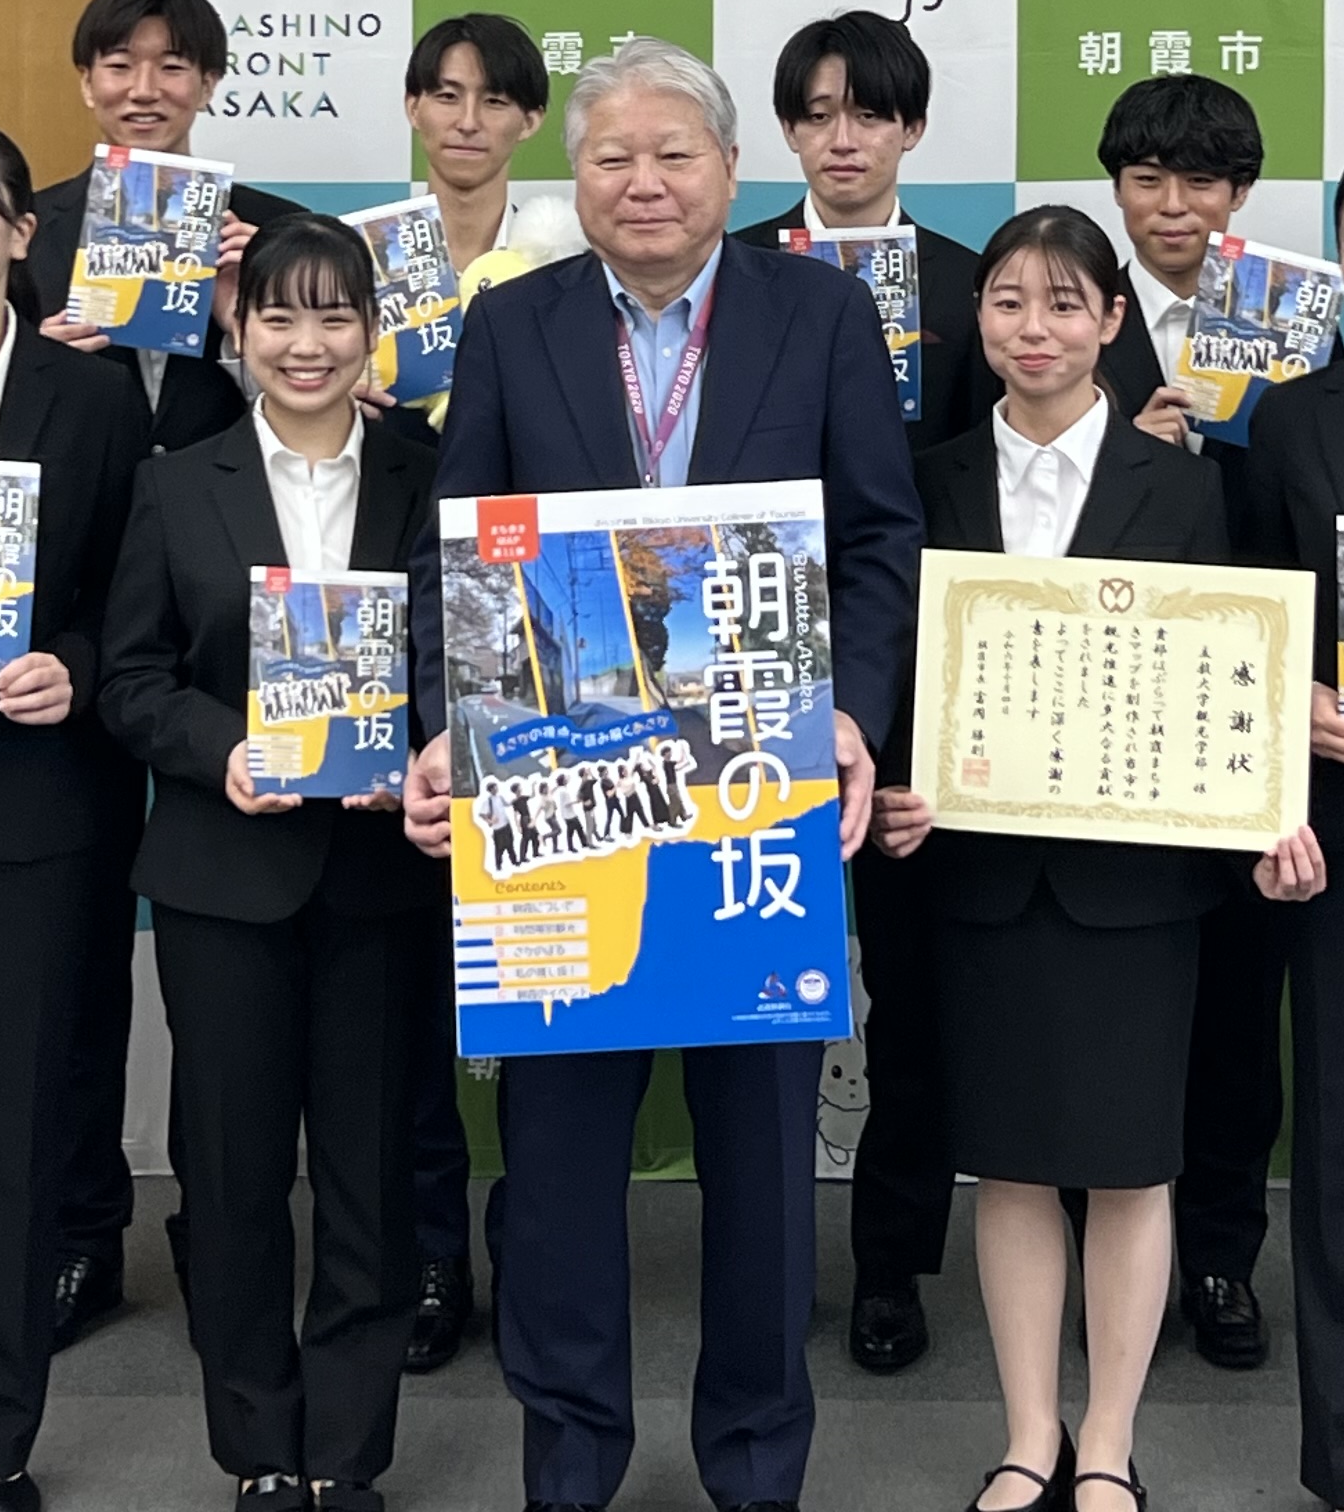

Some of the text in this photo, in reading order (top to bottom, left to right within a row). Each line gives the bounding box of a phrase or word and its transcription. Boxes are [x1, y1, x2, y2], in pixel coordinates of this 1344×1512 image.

[230, 13, 382, 38] ASHINO
[1077, 29, 1263, 76] 朝霞市
[161, 181, 217, 316] 朝霞の坂
[397, 218, 456, 356] 朝霞の坂
[617, 344, 644, 414] TOKYO 2020
[667, 345, 701, 416] TOKYO 2020
[354, 597, 395, 751] 朝霞の坂
[1226, 660, 1257, 775] 感謝状
[702, 551, 807, 921] 朝霞の坂
